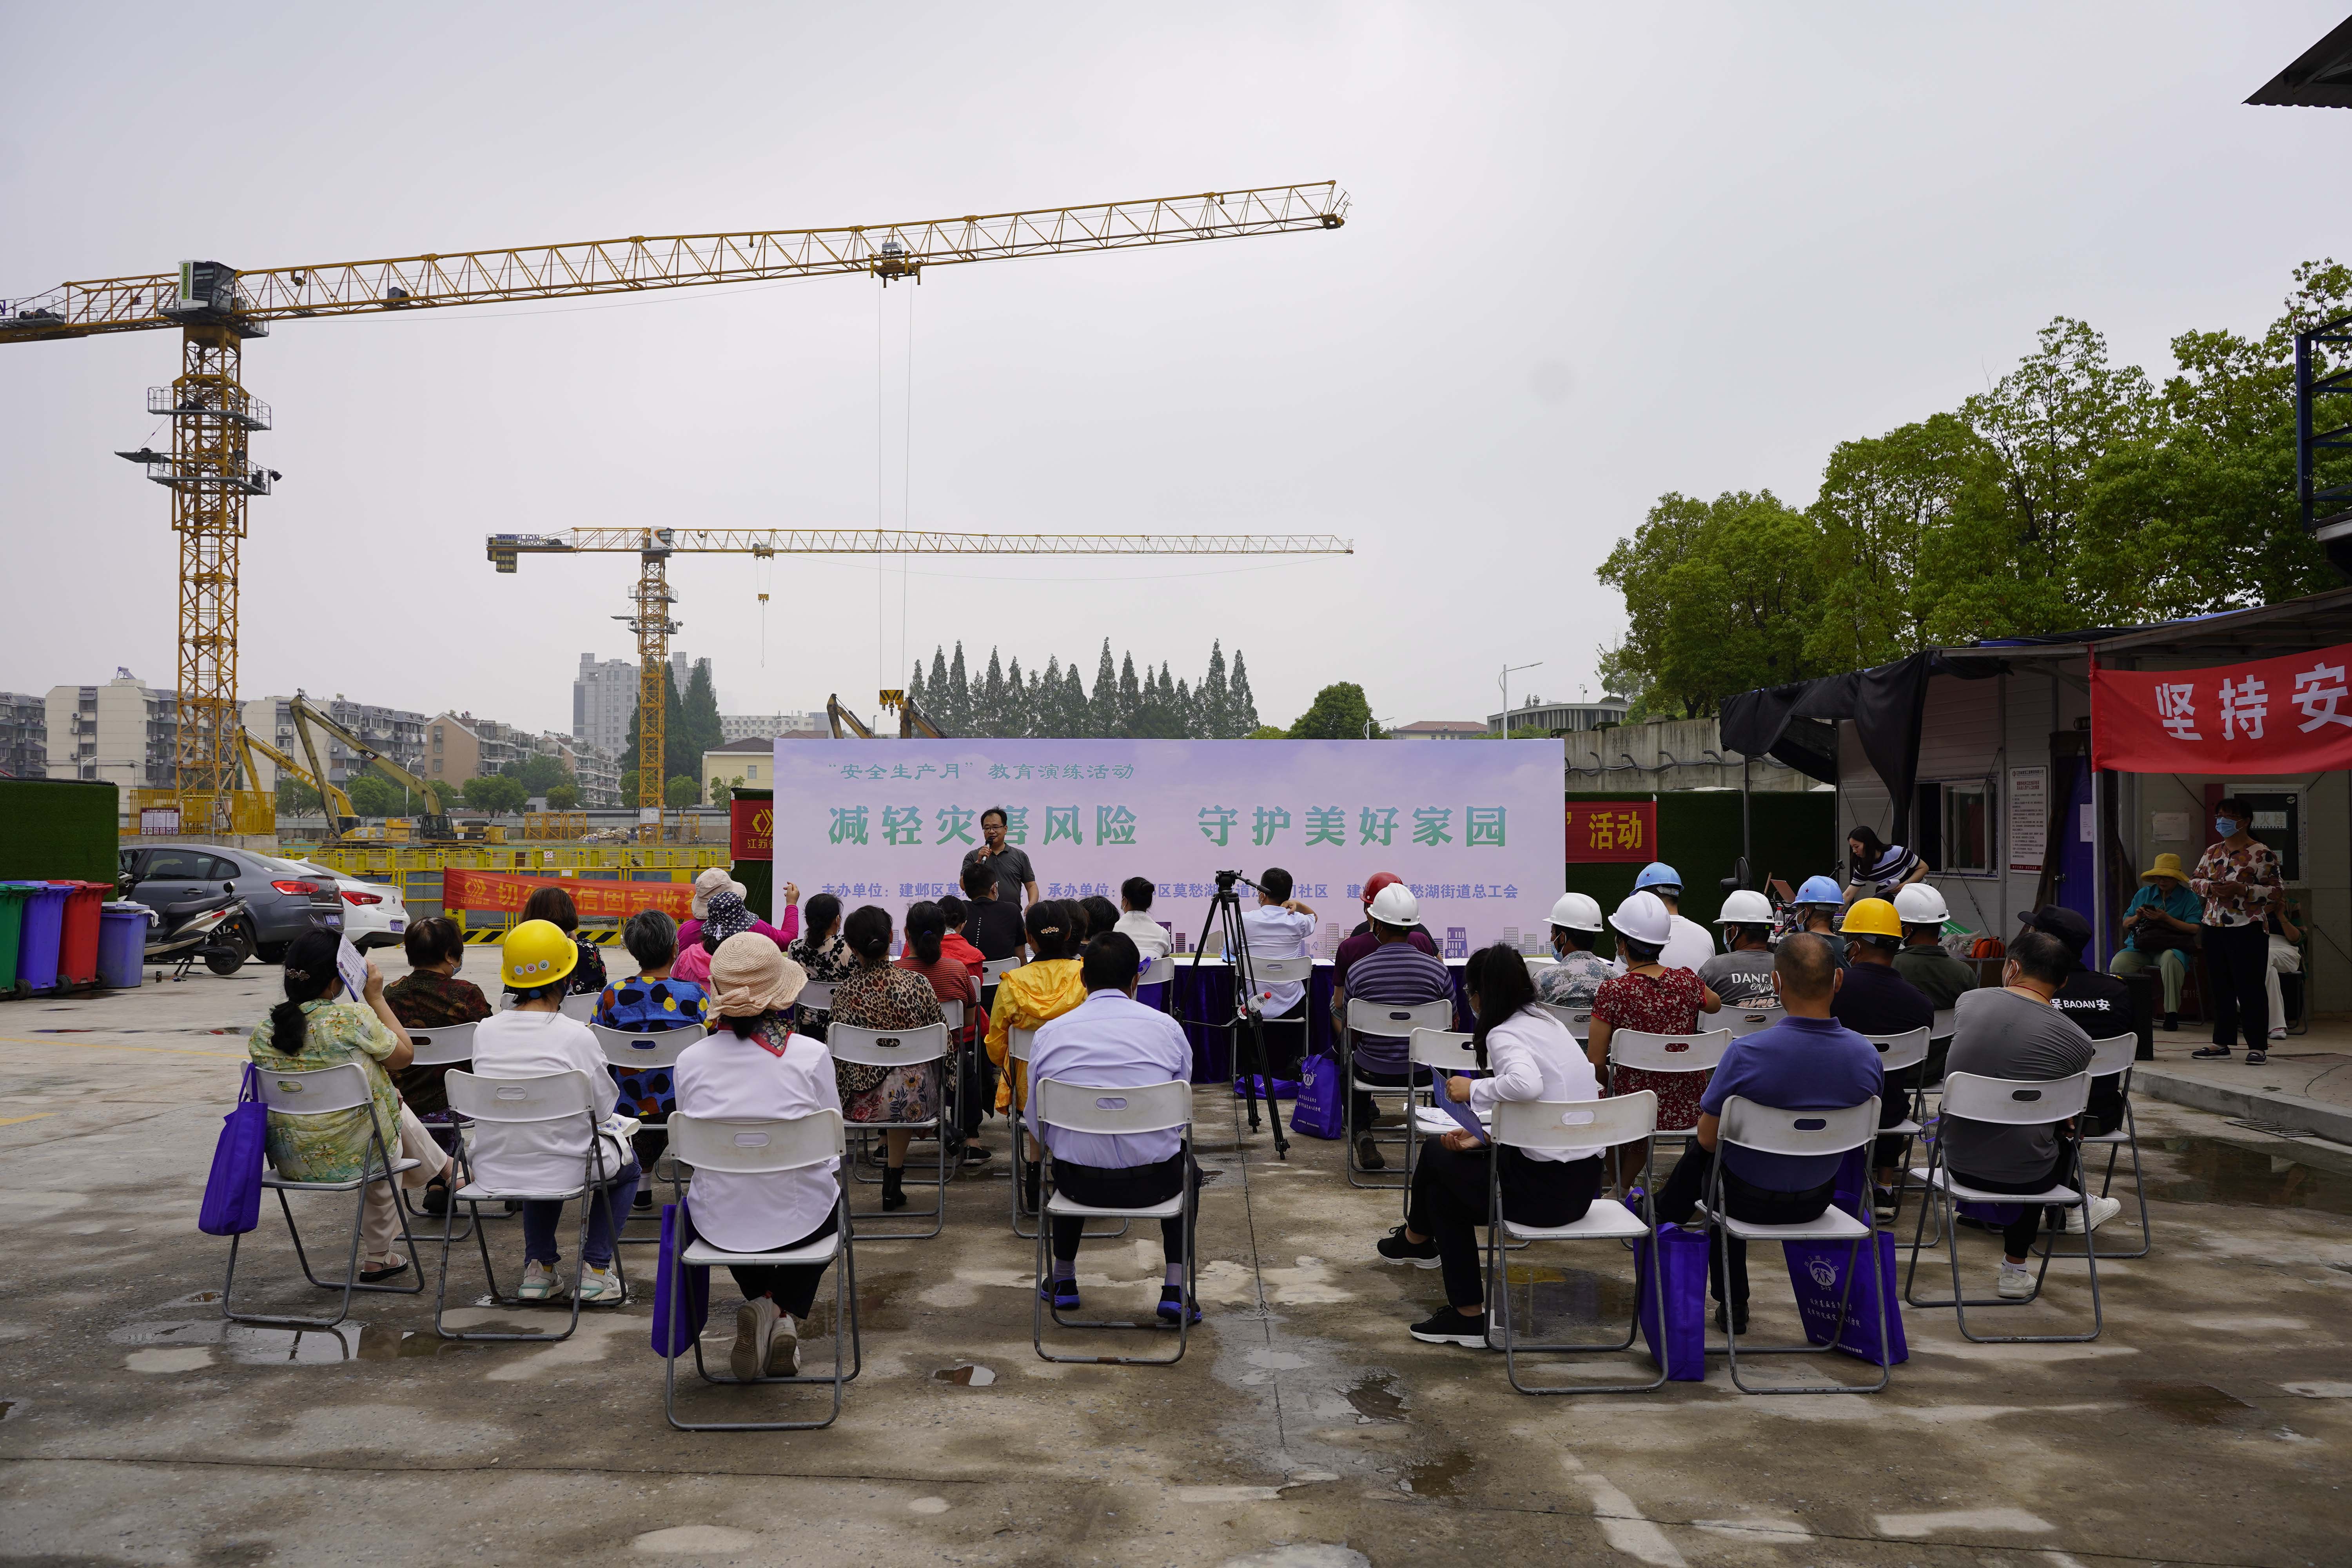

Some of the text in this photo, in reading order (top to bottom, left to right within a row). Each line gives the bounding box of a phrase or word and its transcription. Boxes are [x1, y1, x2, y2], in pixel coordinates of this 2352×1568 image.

[1198, 805, 1507, 847] 守护美好家园
